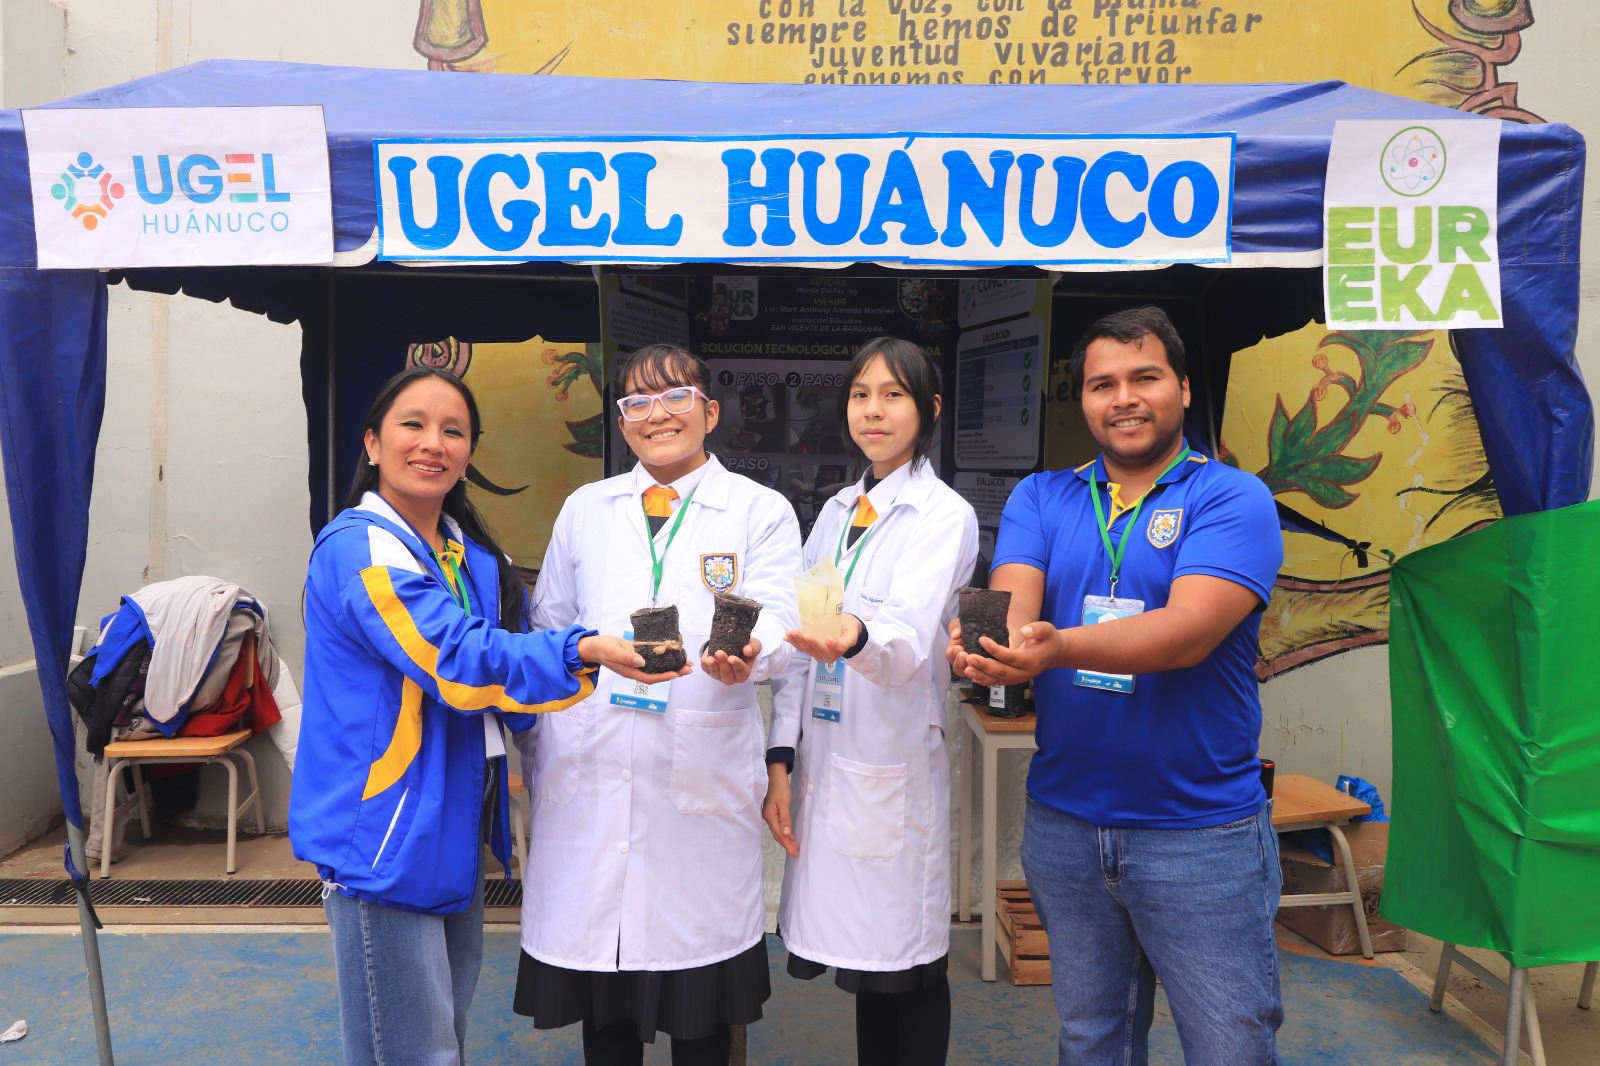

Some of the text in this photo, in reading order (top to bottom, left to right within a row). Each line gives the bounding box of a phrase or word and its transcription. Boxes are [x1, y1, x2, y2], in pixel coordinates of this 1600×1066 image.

[759, 0, 815, 19] con
[727, 20, 867, 54] siempre
[899, 9, 1011, 41] hemos
[1041, 7, 1078, 37] de
[812, 36, 1178, 68] juventud vivariana
[988, 67, 1047, 85] con
[1081, 61, 1192, 84] fervor
[131, 153, 291, 205] UGEL
[387, 137, 1220, 252] UGEL HUÁNUCO
[142, 208, 290, 235] HUÁNUCO
[1328, 205, 1492, 265] EUR
[809, 278, 848, 287] AUTORA
[811, 297, 847, 306] ASESOR
[1327, 264, 1500, 323] EKA
[799, 306, 831, 315] Anthony
[831, 325, 842, 333] LA
[842, 326, 883, 334] BARQUERA
[701, 340, 763, 354] SOLUCIÓN
[764, 342, 849, 355] TECNOLÓGICA
[735, 372, 779, 386] PASO
[802, 373, 845, 388] PASO
[726, 457, 769, 471] PASO
